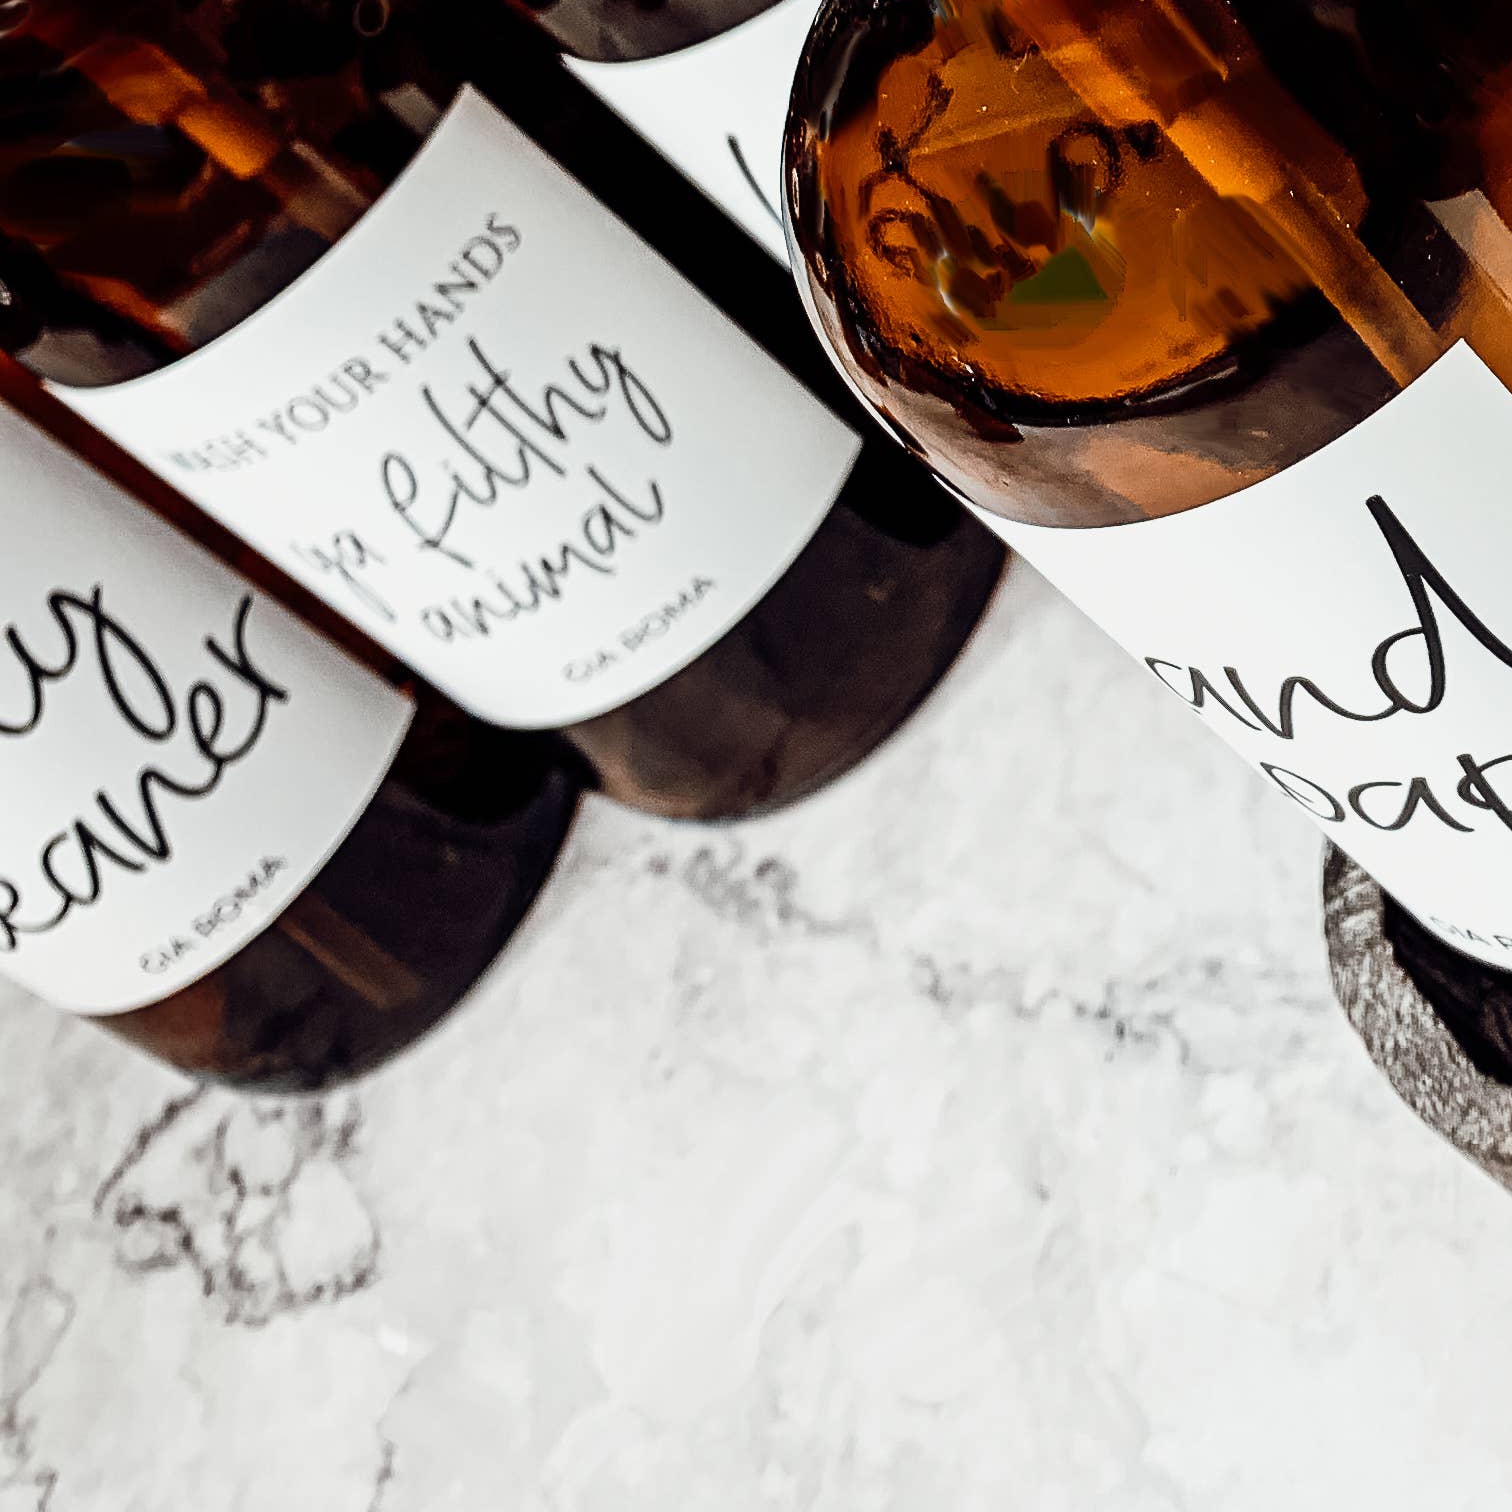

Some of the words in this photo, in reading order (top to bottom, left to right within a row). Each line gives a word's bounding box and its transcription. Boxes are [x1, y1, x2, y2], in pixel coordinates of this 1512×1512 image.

[255, 356, 391, 445] YOUR
[376, 211, 522, 365] HANDS
[382, 336, 674, 569] filthy
[422, 465, 664, 642] animal
